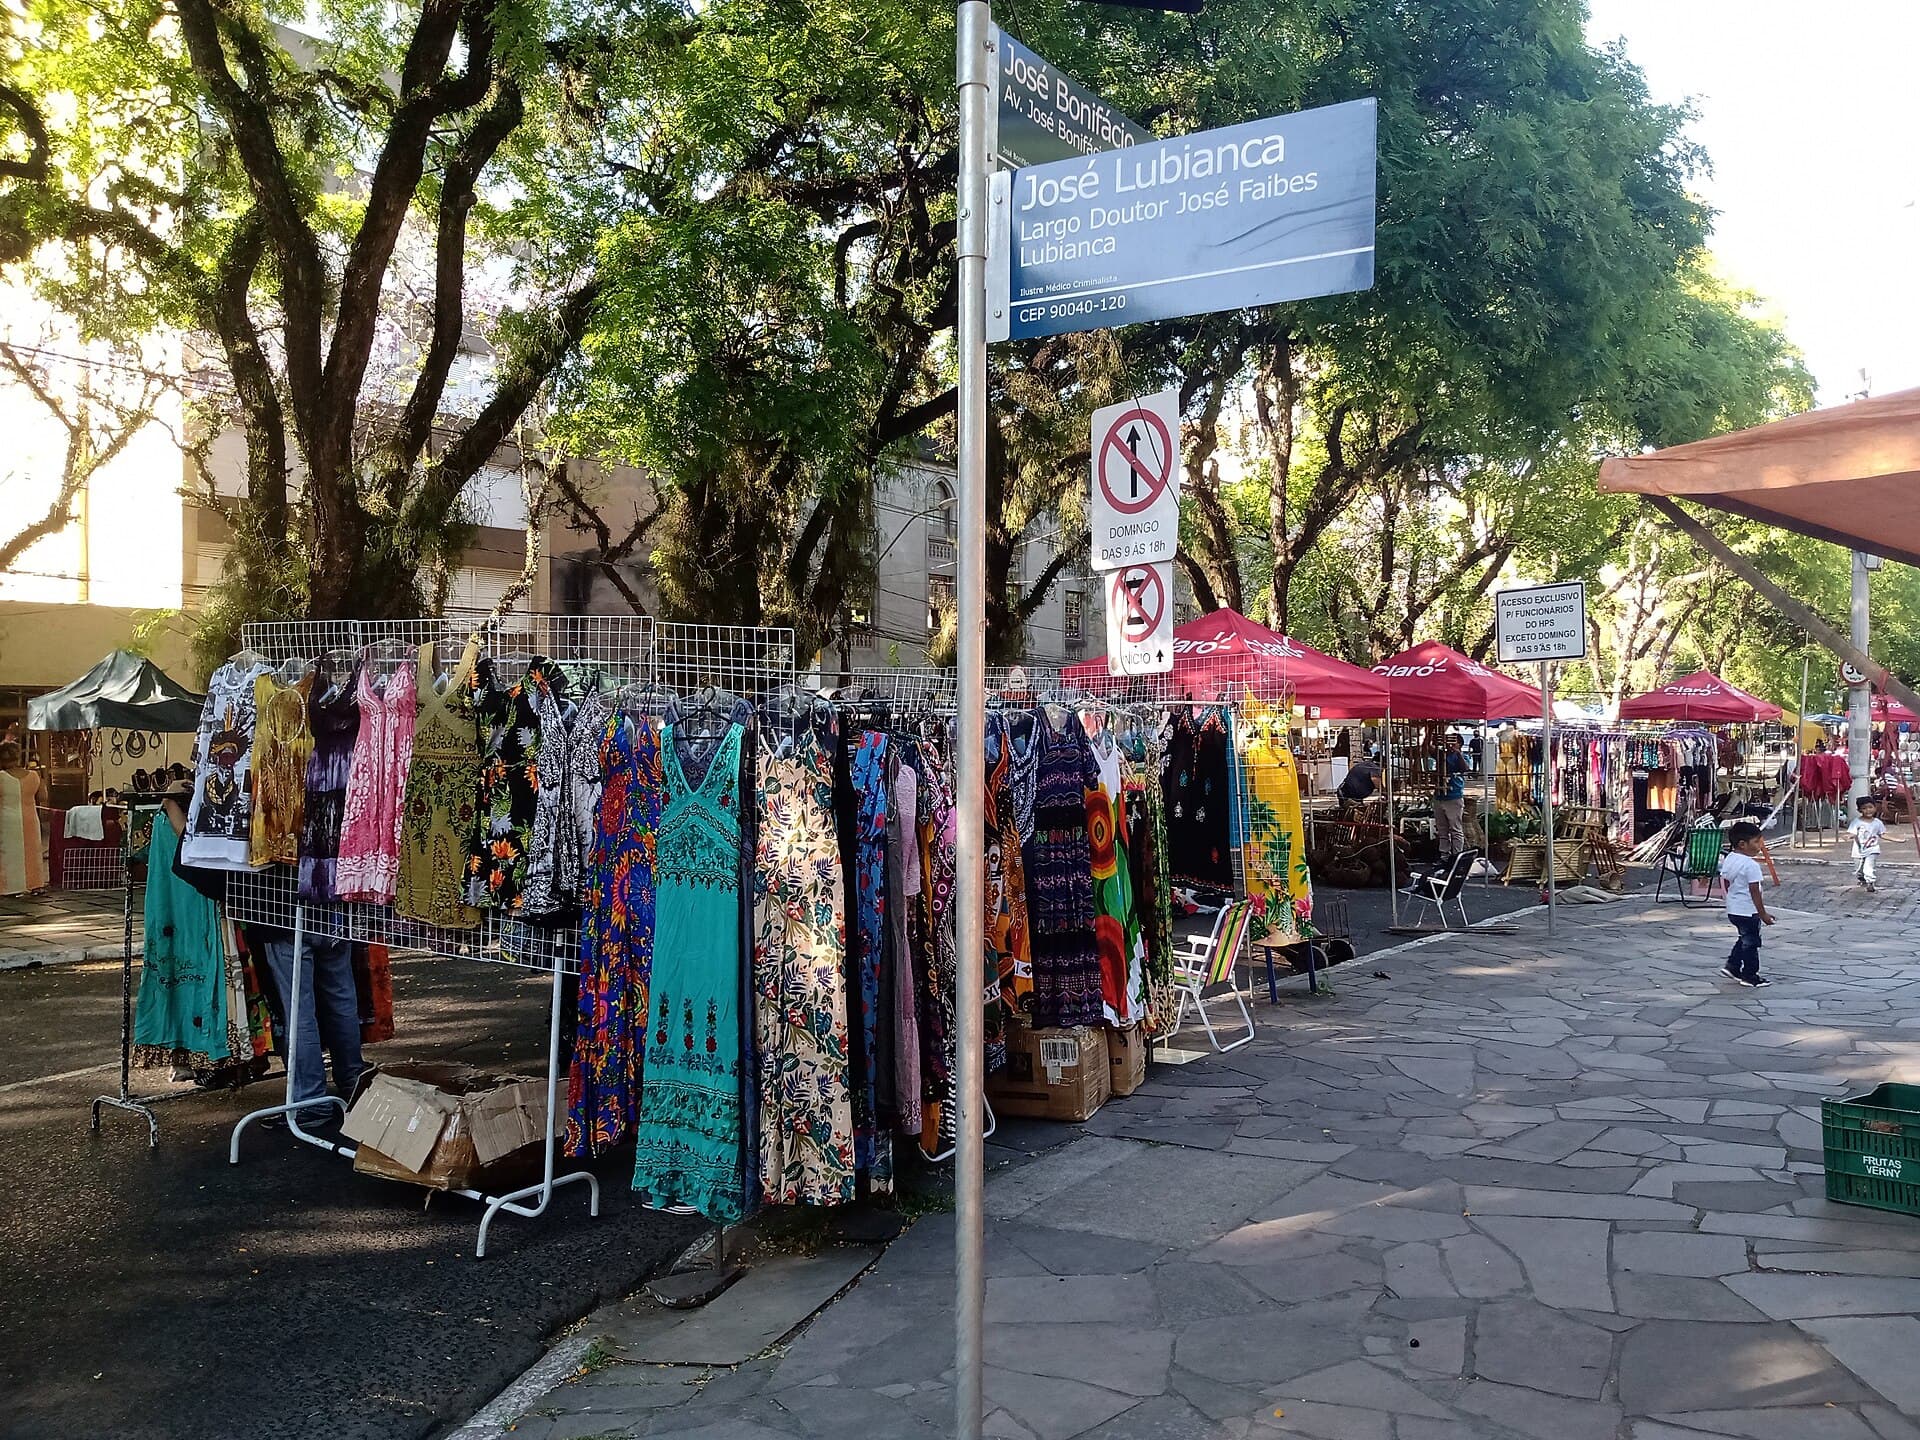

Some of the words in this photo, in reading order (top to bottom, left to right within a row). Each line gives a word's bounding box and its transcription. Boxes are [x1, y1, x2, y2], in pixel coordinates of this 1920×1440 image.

[1005, 43, 1048, 100] José
[1056, 78, 1134, 149] Bonifácio
[1004, 85, 1023, 112] Av.
[1027, 100, 1054, 132] José
[1020, 158, 1099, 211] José
[1115, 135, 1285, 194] Lubianca
[1020, 217, 1081, 242] Largo
[1090, 199, 1168, 230] Doutor
[1176, 183, 1230, 215] José
[1239, 171, 1319, 203] Faibes
[1020, 235, 1116, 268] Lubianca
[1020, 286, 1044, 297] Ilustre
[1046, 282, 1071, 292] Médico
[1073, 275, 1118, 289] Criminalista
[1020, 307, 1046, 322] CEP
[1050, 295, 1126, 319] 90040-120
[1109, 520, 1159, 539] DOMINGO
[1101, 547, 1122, 560] DAS
[1124, 546, 1130, 557] 9
[1149, 540, 1166, 553] 18h
[1501, 597, 1533, 607] ACESSO
[1534, 592, 1579, 604] EXCLUSIVO
[1539, 619, 1555, 628] HPS
[1505, 633, 1537, 643] EXCETO
[1538, 630, 1576, 640] DOMINGO
[1516, 645, 1532, 654] DAS
[1533, 644, 1538, 652] 9
[1553, 642, 1567, 651] 18h
[1863, 1155, 1902, 1170] FRUTAS
[1866, 1165, 1900, 1179] VERNY
